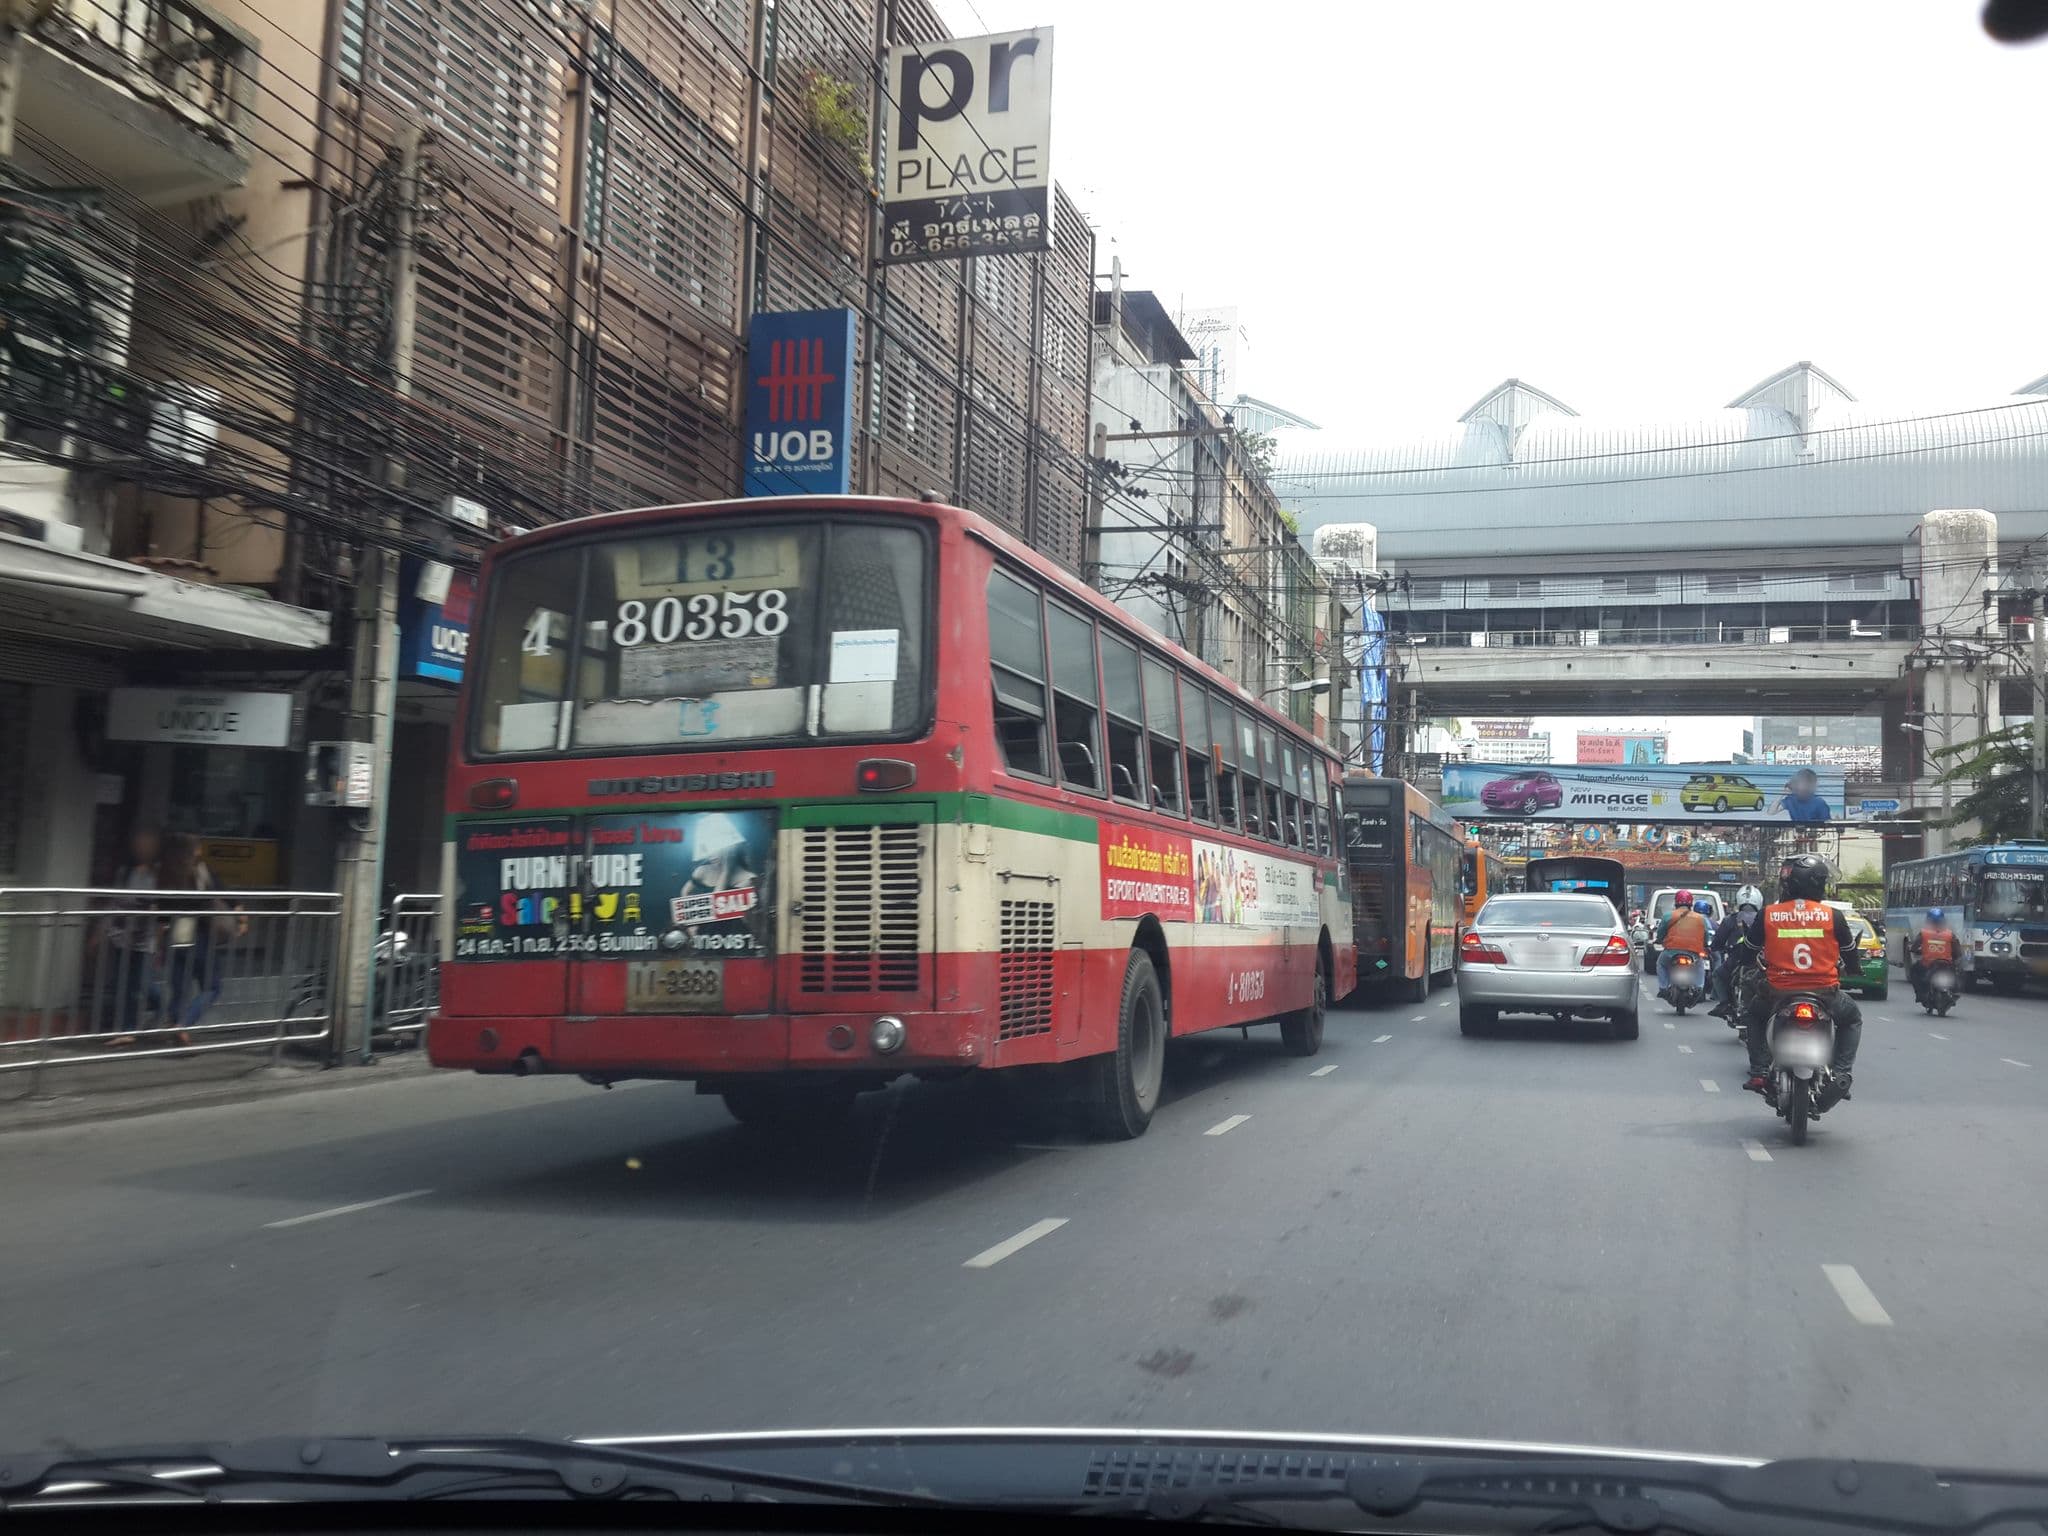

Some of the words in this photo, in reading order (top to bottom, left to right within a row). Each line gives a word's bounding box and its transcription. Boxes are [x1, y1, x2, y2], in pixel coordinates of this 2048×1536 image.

[898, 37, 1041, 151] pr
[897, 145, 1038, 194] PLACE
[754, 430, 833, 463] UOB
[588, 770, 776, 796] MITSUBISHI
[1570, 794, 1649, 805] MIRAGE
[1991, 852, 2008, 864] 17
[1107, 878, 1136, 901] EXPORT
[714, 892, 758, 914] SALE
[1769, 907, 1830, 927] เขตปทุมวัน
[1793, 943, 1813, 970] 6
